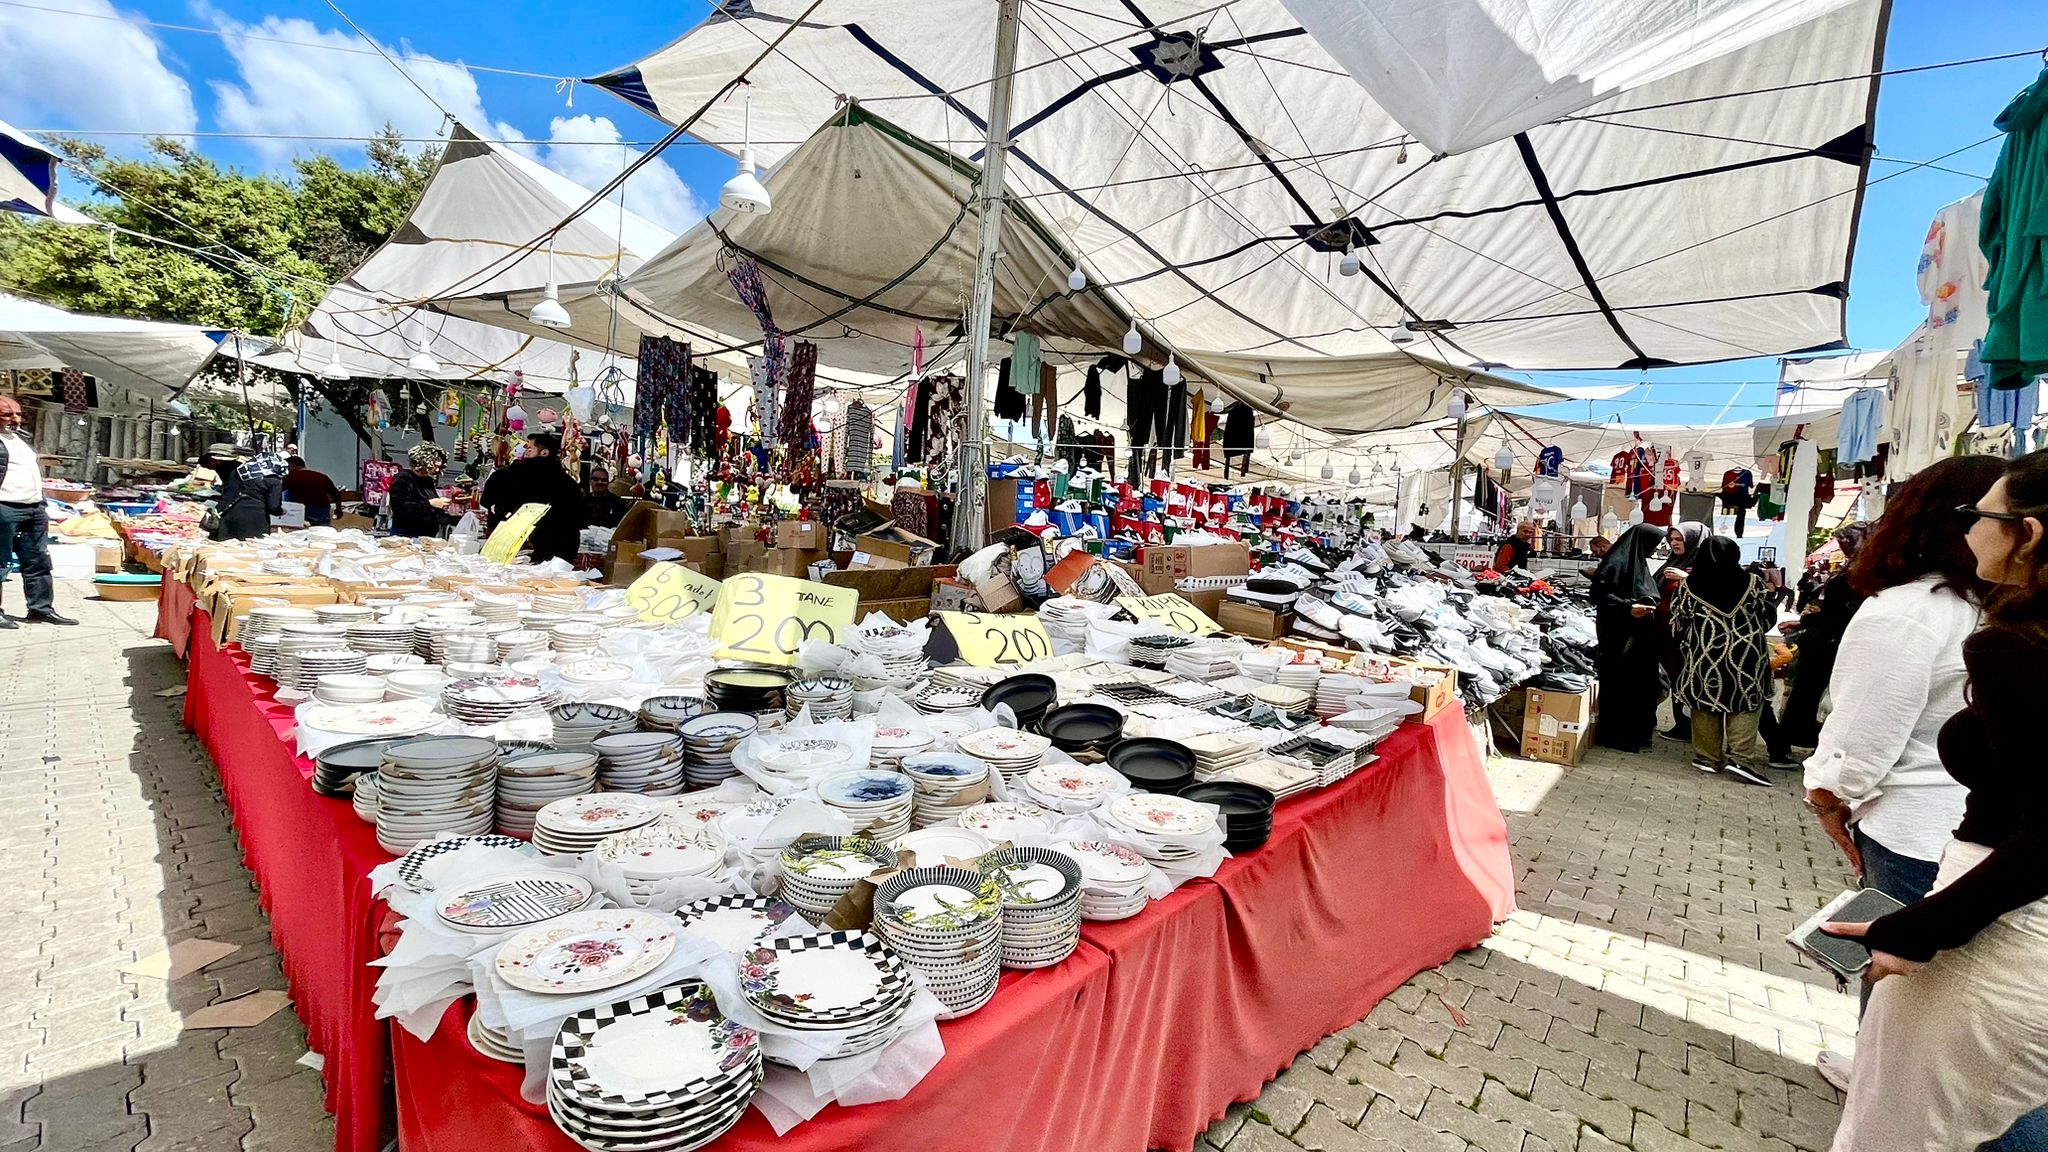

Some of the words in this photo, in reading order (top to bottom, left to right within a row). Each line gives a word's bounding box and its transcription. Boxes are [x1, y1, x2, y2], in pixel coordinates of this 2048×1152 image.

[656, 565, 676, 584] 6
[637, 587, 700, 620] 300
[734, 576, 765, 606] 3
[797, 592, 834, 608] TANE
[1135, 596, 1189, 611] KUPA
[728, 614, 834, 654] 200
[986, 628, 1048, 664] 200
